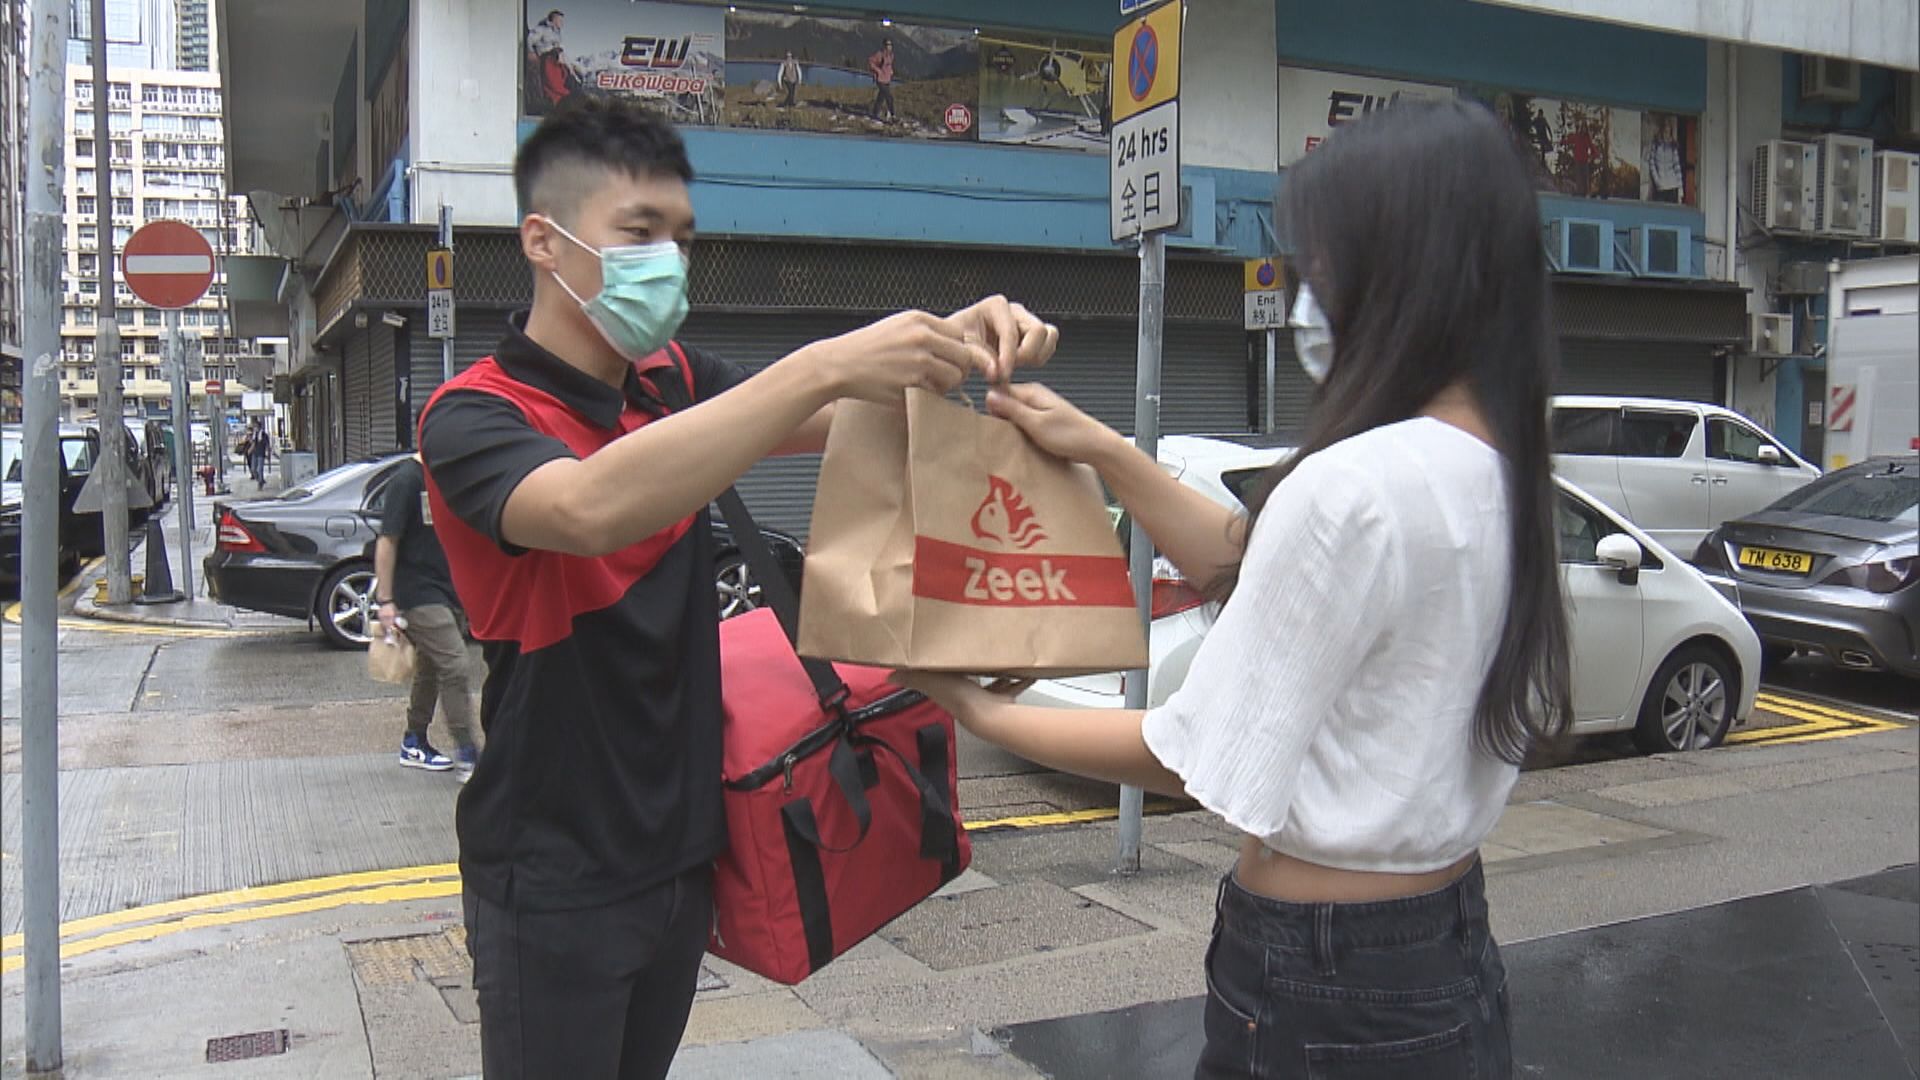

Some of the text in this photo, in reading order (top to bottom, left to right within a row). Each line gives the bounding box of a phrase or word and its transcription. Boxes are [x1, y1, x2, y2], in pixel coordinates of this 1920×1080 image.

[620, 35, 693, 68] EW
[1118, 126, 1168, 168] 24 hrs
[1121, 171, 1160, 222] 全日
[1253, 308, 1280, 324] 終止
[1257, 294, 1276, 306] End
[1749, 550, 1802, 571] TM 638
[963, 556, 1078, 602] Zeek
